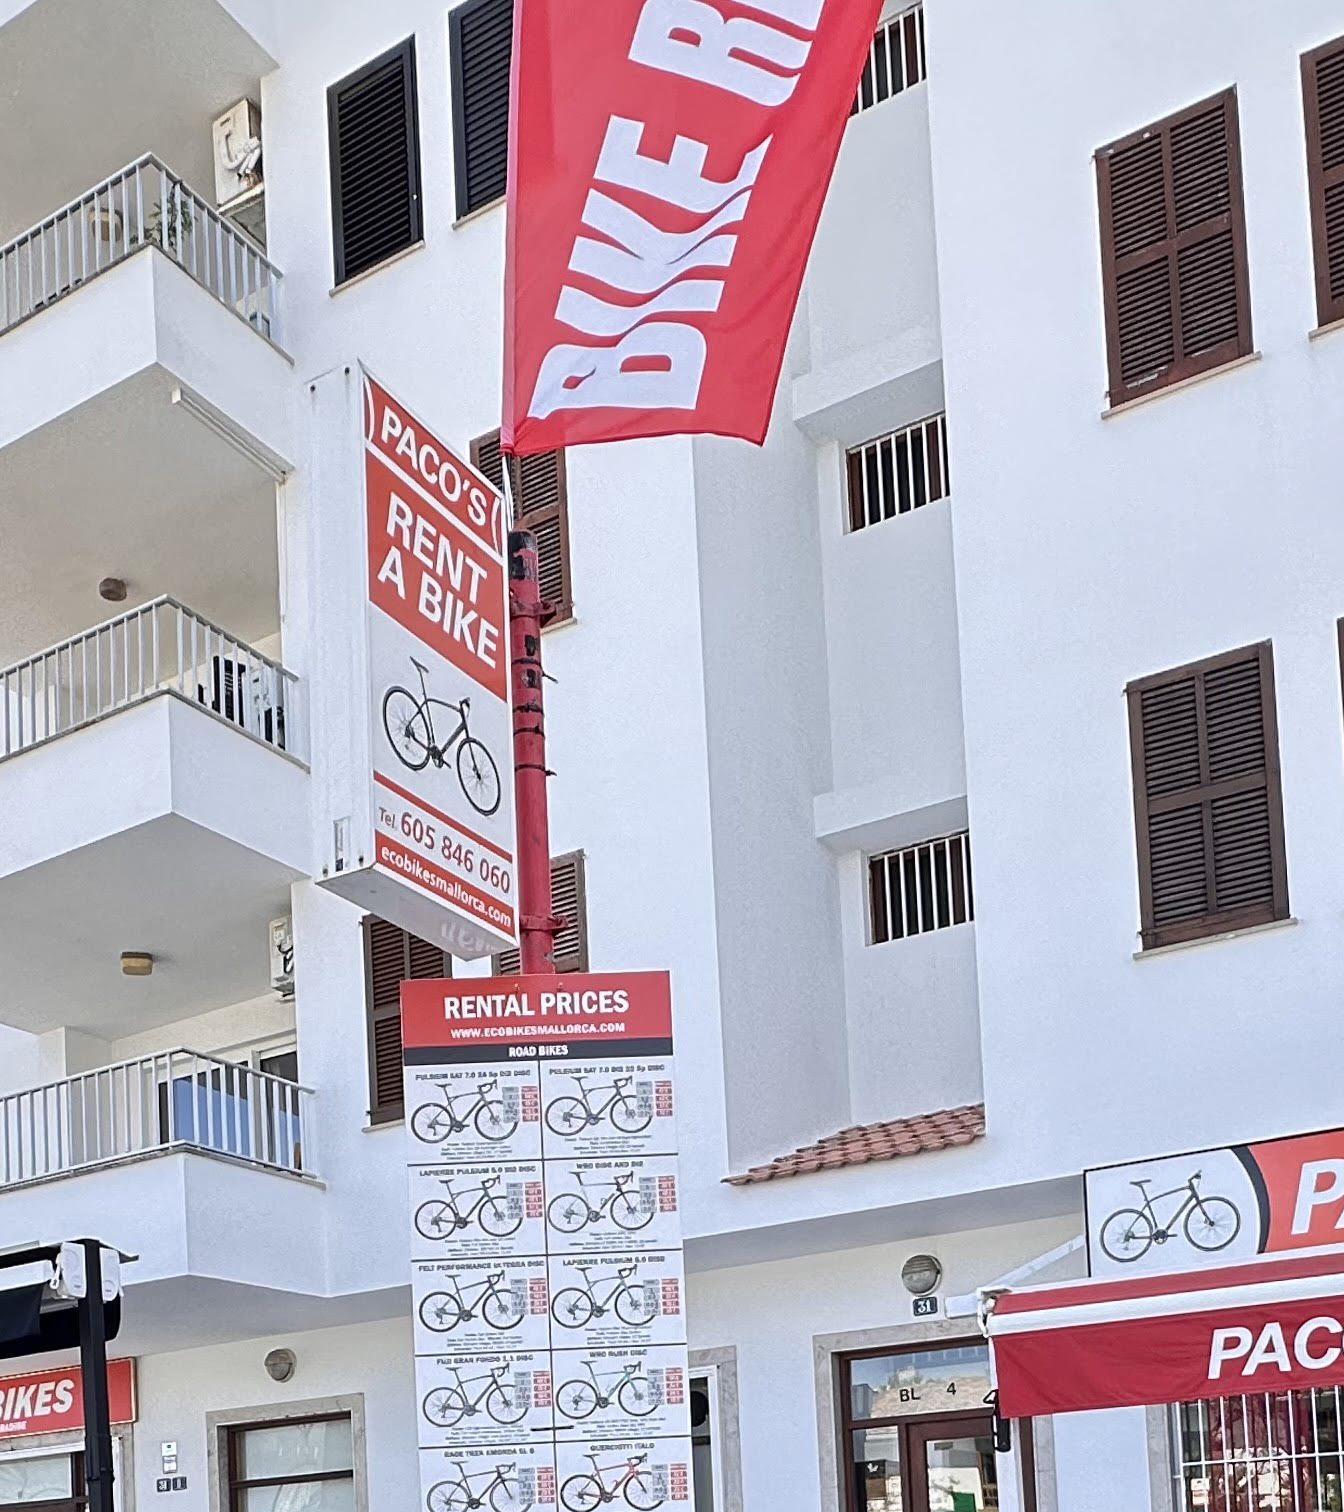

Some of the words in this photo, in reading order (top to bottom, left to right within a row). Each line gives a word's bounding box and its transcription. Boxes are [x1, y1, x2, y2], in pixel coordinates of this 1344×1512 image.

[526, 114, 773, 420] BIKE
[381, 405, 488, 528] PACO'S
[386, 491, 488, 603] RENT
[377, 546, 406, 600] A
[418, 575, 500, 669] BIKE
[381, 845, 511, 928] ecobikesmallorca.com
[401, 811, 436, 850] 605
[440, 835, 474, 873] 846
[479, 858, 510, 893] 060
[444, 993, 535, 1019] RENTAL
[541, 989, 630, 1016] PRICES
[451, 1022, 625, 1039] WWW.ECOBIKESMALLORCA.COM
[508, 1046, 537, 1057] ROAD
[538, 1045, 568, 1056] BIKES
[899, 1388, 921, 1402] BL
[946, 1382, 957, 1395] 4
